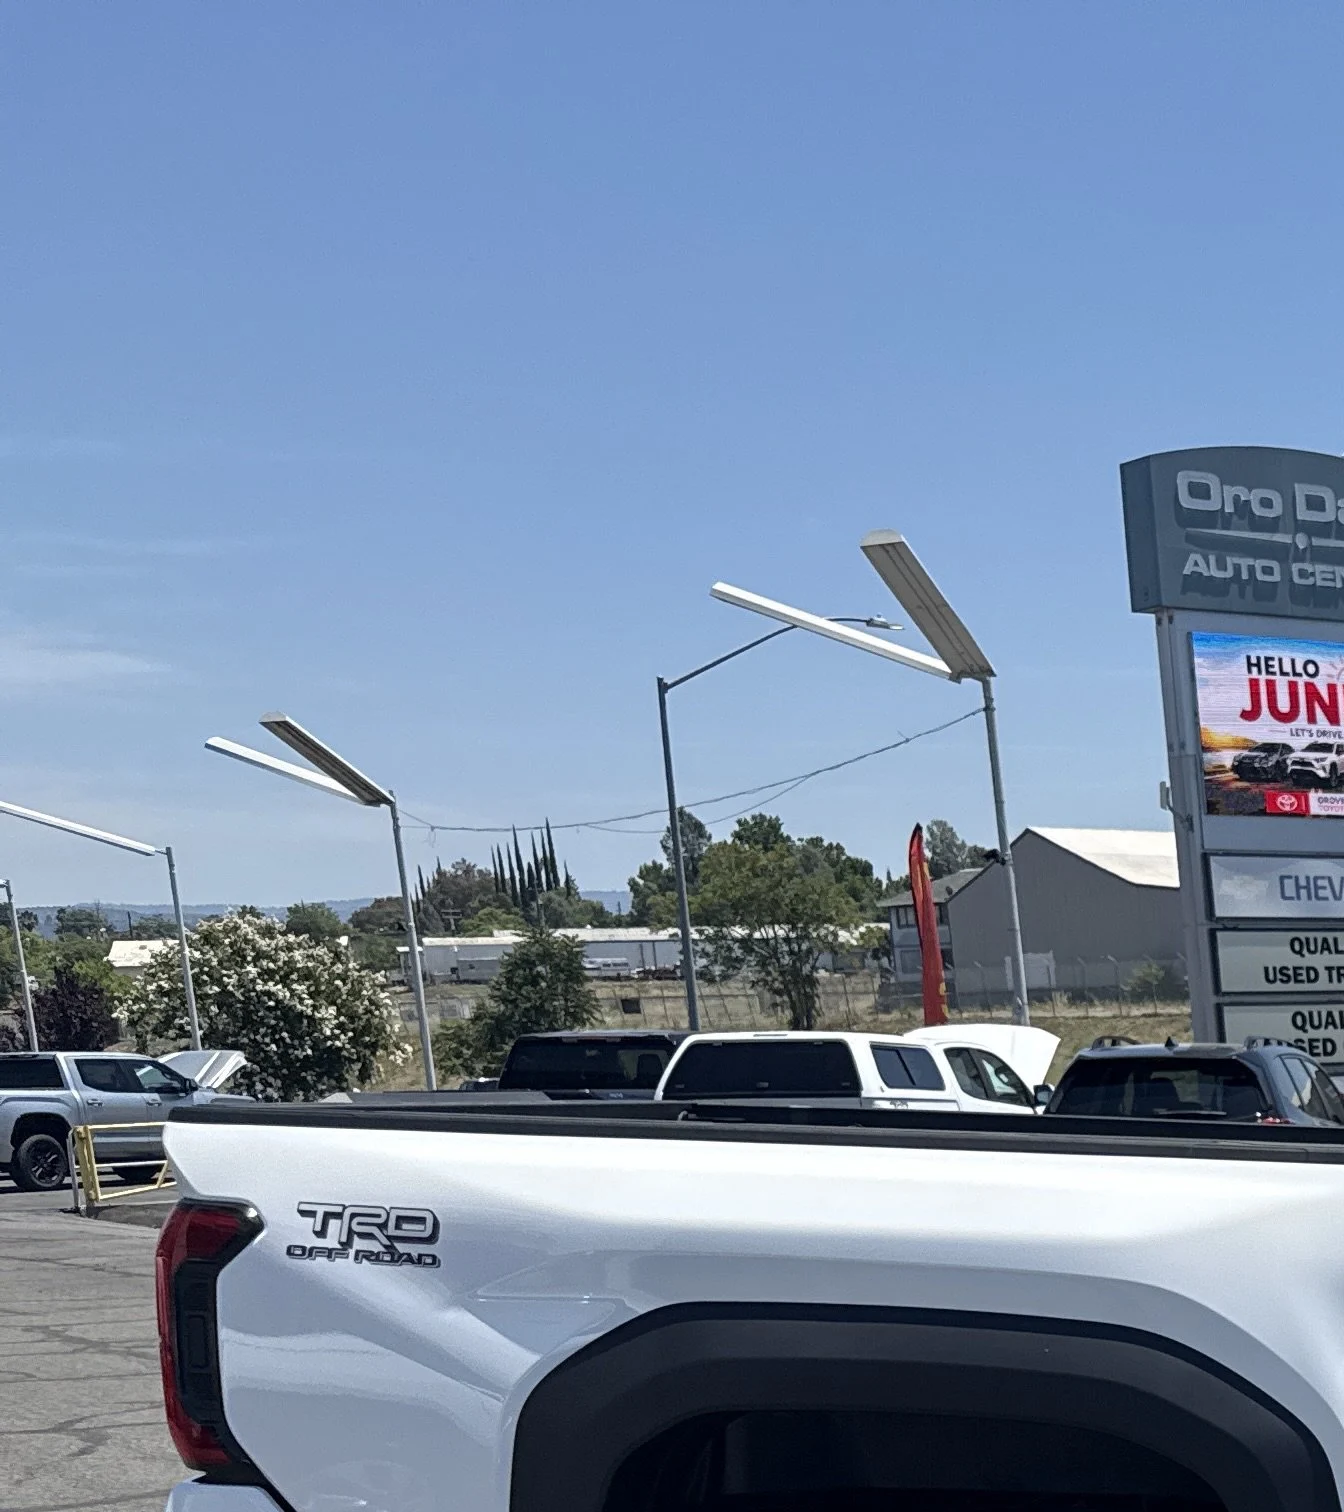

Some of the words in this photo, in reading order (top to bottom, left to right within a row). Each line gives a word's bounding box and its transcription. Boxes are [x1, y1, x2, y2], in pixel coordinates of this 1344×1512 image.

[1176, 470, 1283, 518] Oro
[1183, 553, 1281, 583] AUTO
[1246, 654, 1320, 678] HELLO
[1263, 965, 1320, 985] USED
[1278, 1037, 1338, 1057] SED
[297, 1201, 440, 1250] TRD
[286, 1244, 350, 1262] OFF
[354, 1249, 441, 1268] ROAD
